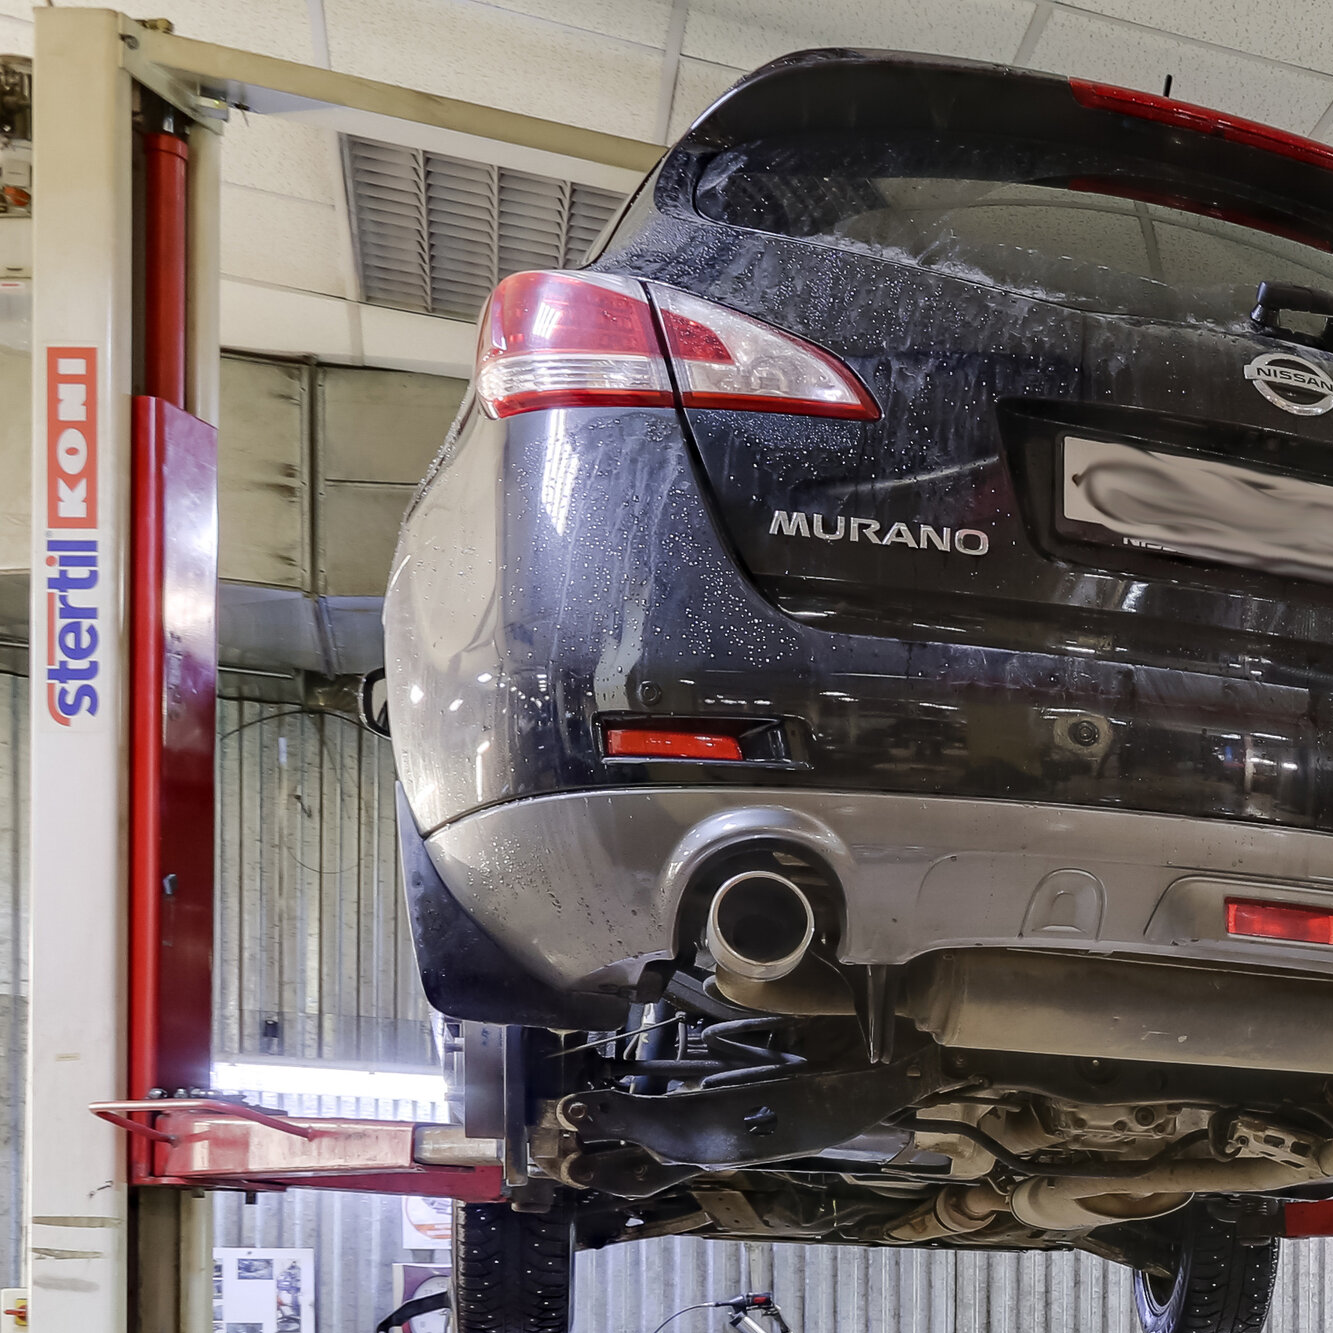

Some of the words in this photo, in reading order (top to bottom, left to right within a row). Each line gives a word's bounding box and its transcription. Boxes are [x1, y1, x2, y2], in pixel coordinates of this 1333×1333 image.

[56, 357, 89, 518] KONI
[768, 509, 990, 556] MURANO
[46, 539, 99, 727] stertil
